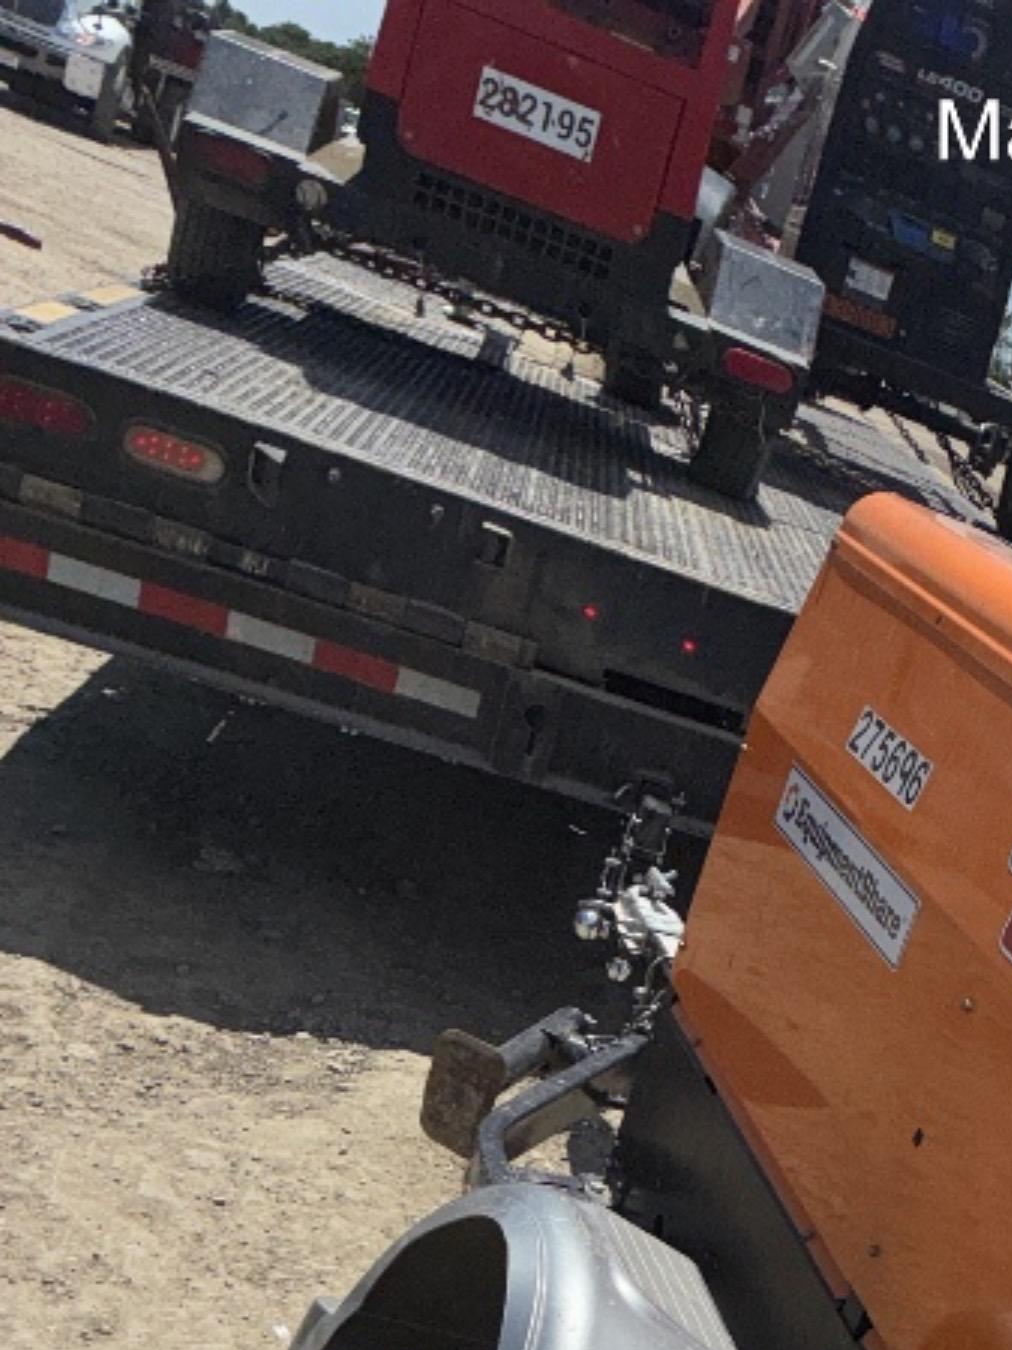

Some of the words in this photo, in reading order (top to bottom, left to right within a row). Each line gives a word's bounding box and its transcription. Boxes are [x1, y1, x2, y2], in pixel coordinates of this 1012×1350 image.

[479, 77, 595, 148] 282195
[847, 710, 931, 805] 275696
[794, 796, 902, 941] EquipmentShare
